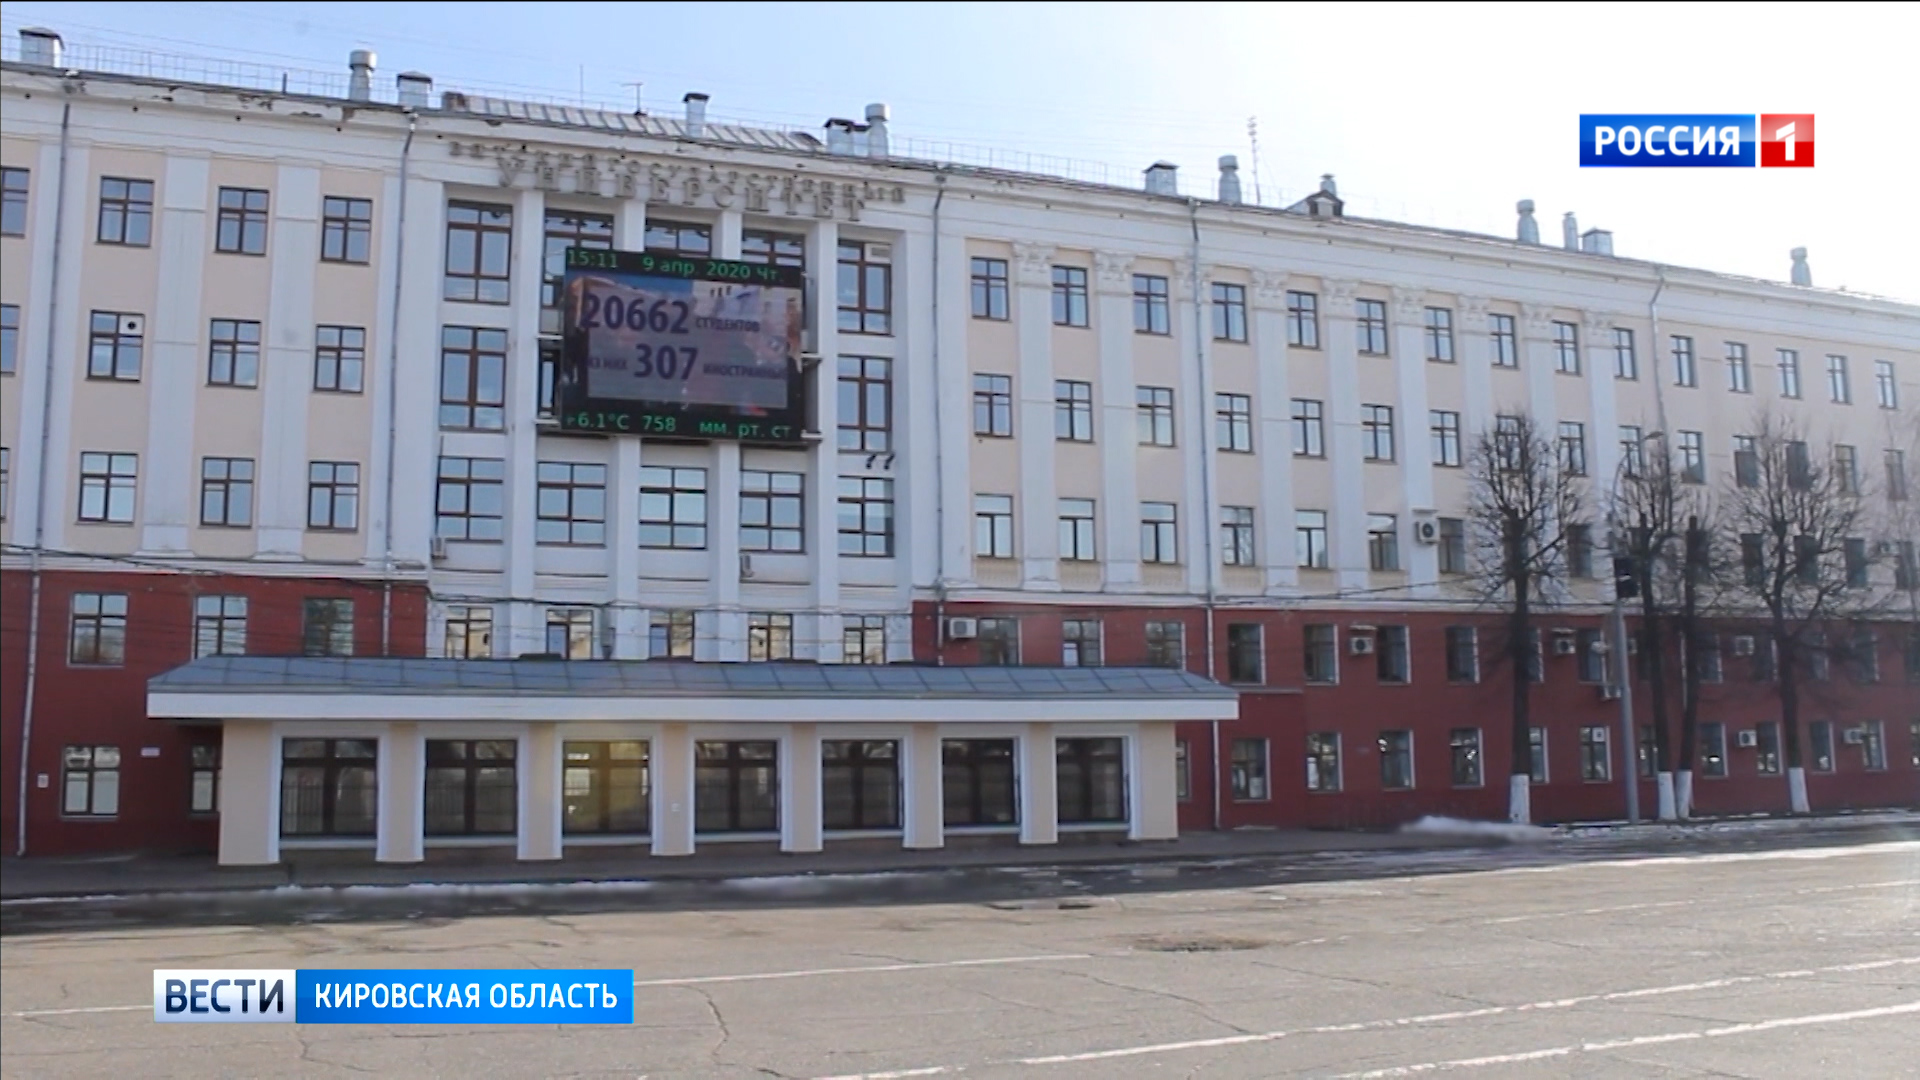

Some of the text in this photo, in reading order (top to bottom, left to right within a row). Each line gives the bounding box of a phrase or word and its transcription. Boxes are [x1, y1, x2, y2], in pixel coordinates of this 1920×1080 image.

[495, 156, 865, 222] УНИВЕРСИТЕТ
[567, 250, 618, 268] 15:11
[641, 256, 654, 271] 9
[706, 261, 751, 279] 2020
[580, 292, 761, 334] 20662 СТУДЕНТОВ
[633, 343, 698, 380] 307
[642, 415, 677, 432] 758
